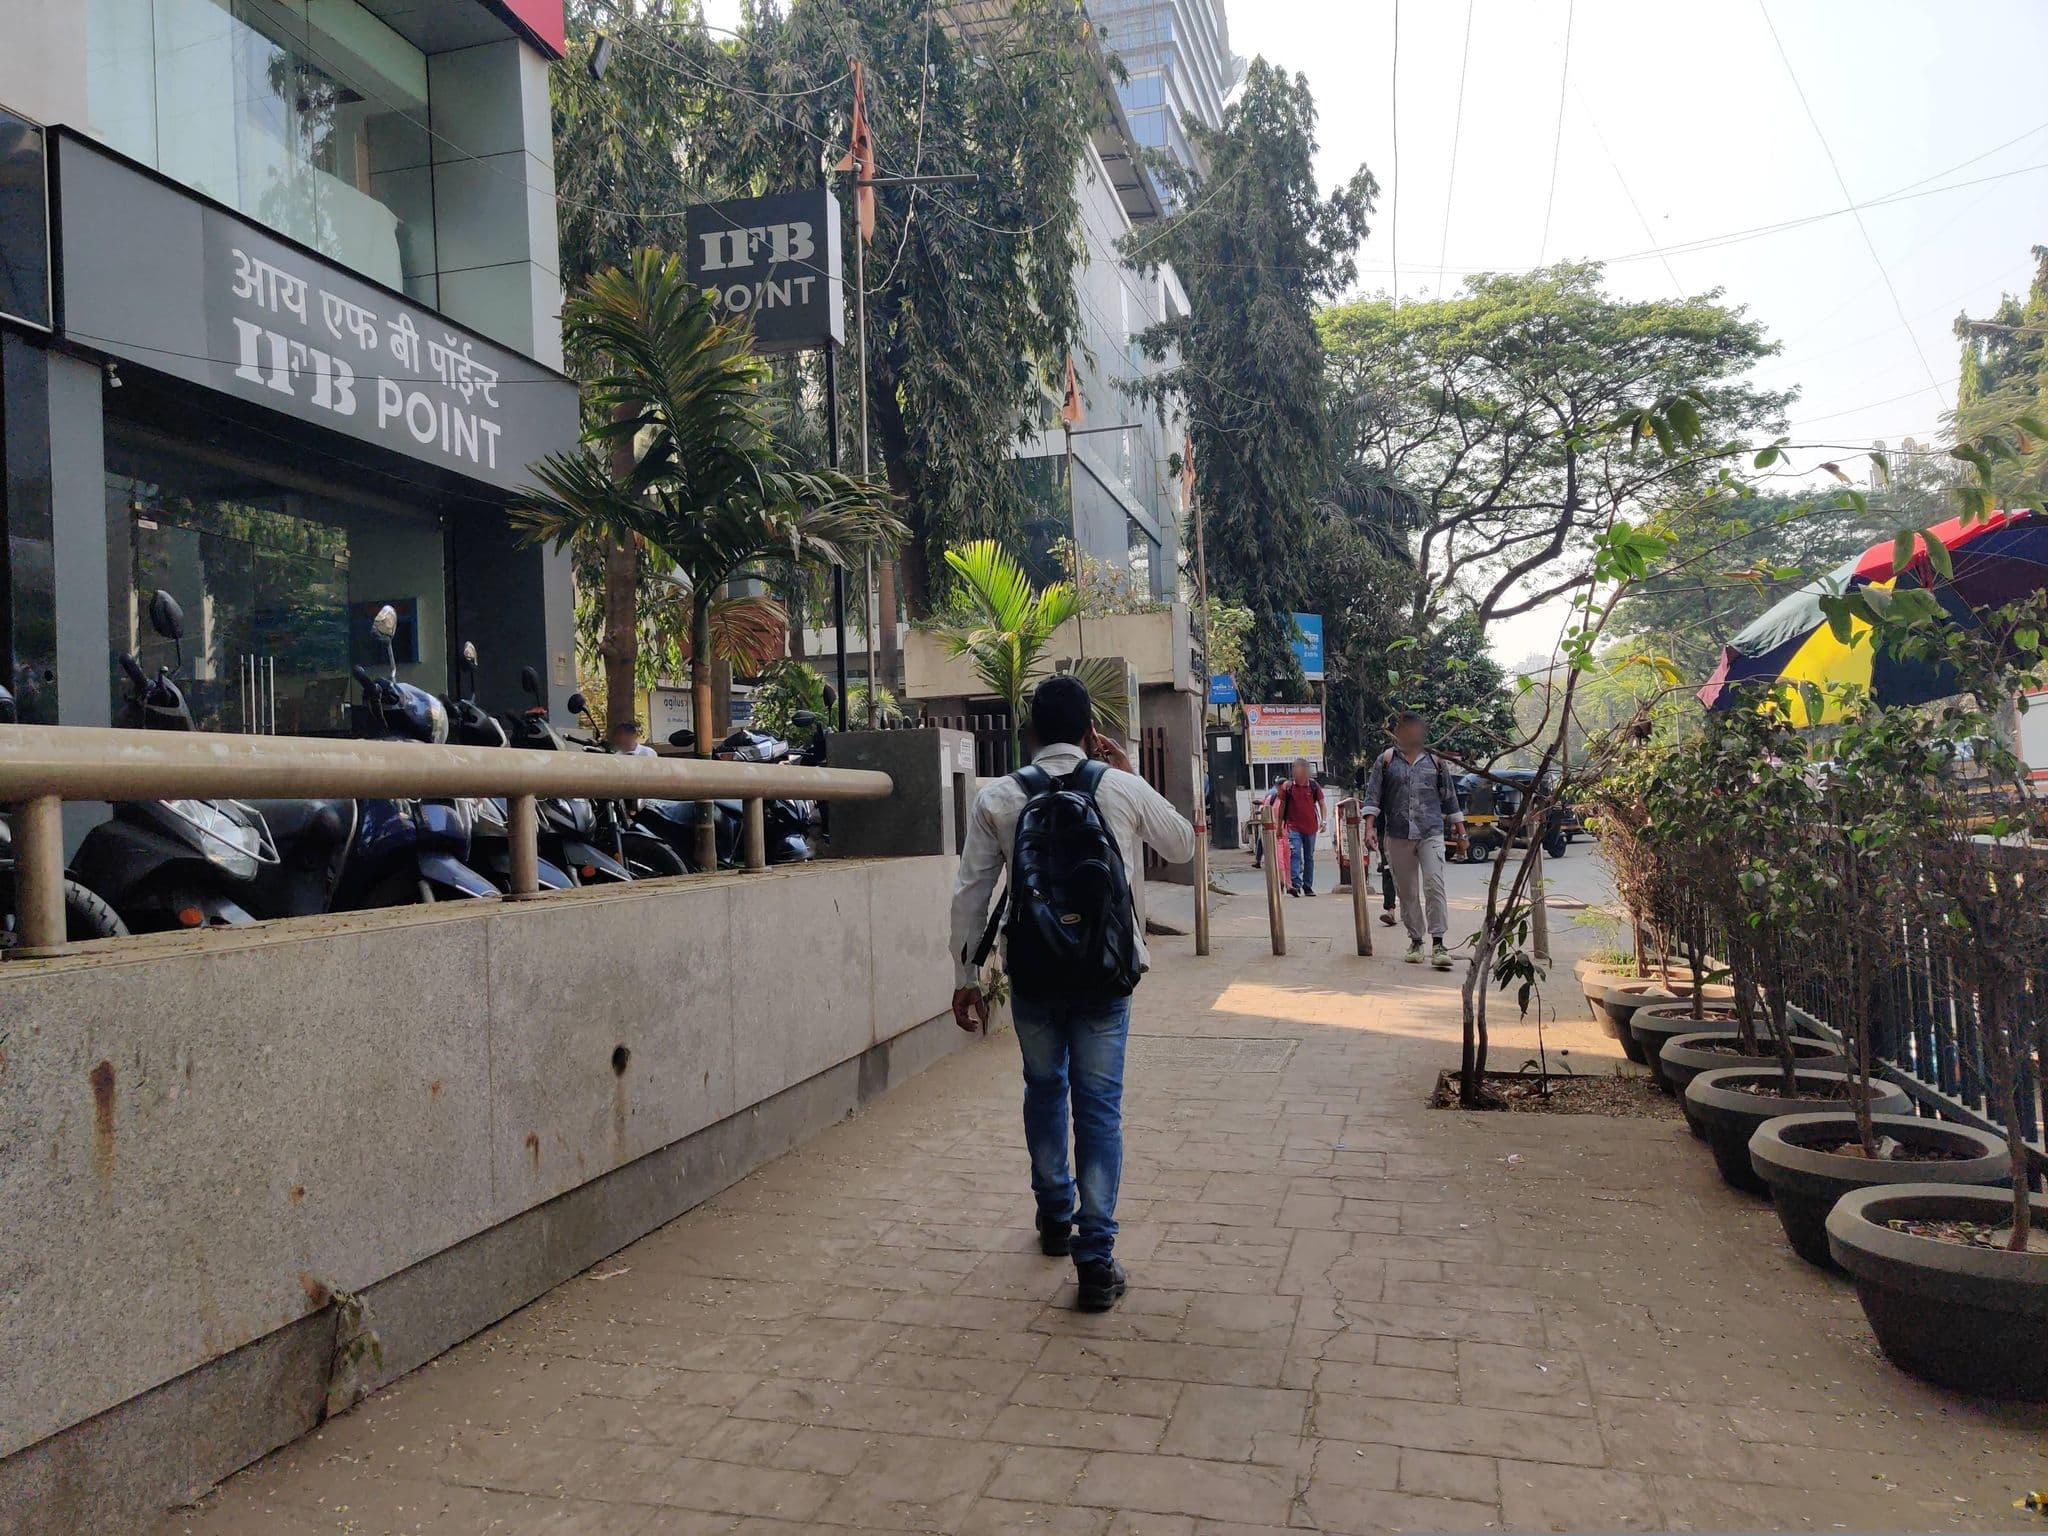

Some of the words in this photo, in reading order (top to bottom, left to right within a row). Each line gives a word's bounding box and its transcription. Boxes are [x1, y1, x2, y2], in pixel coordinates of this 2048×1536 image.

[699, 221, 815, 272] IFB
[232, 249, 308, 325] आय
[319, 288, 378, 350] एफ
[387, 312, 420, 373] बी
[428, 333, 500, 408] पॉईन्ट
[232, 316, 357, 416] IFB
[378, 375, 501, 469] POINT
